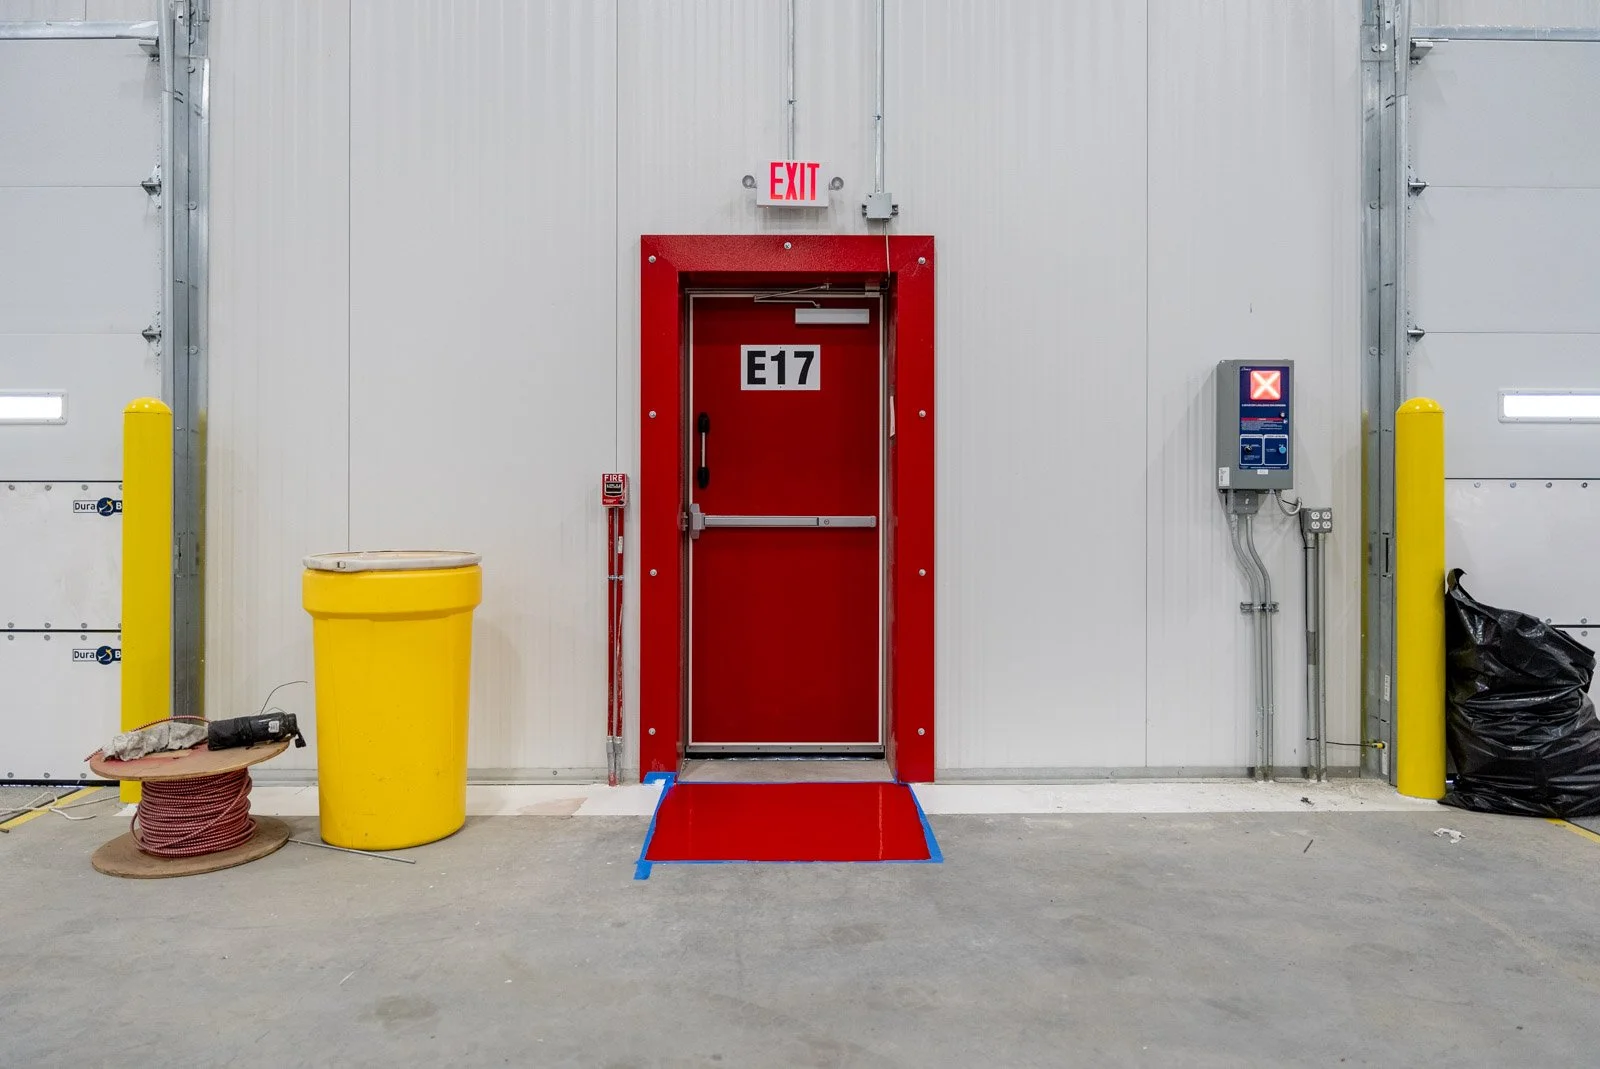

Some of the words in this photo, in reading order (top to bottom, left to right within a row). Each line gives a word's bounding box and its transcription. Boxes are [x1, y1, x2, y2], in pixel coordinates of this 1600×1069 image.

[770, 162, 820, 200] EXIT
[746, 350, 815, 385] E17
[604, 474, 623, 482] FIRE
[74, 502, 96, 510] Dura
[74, 650, 95, 659] Dura
